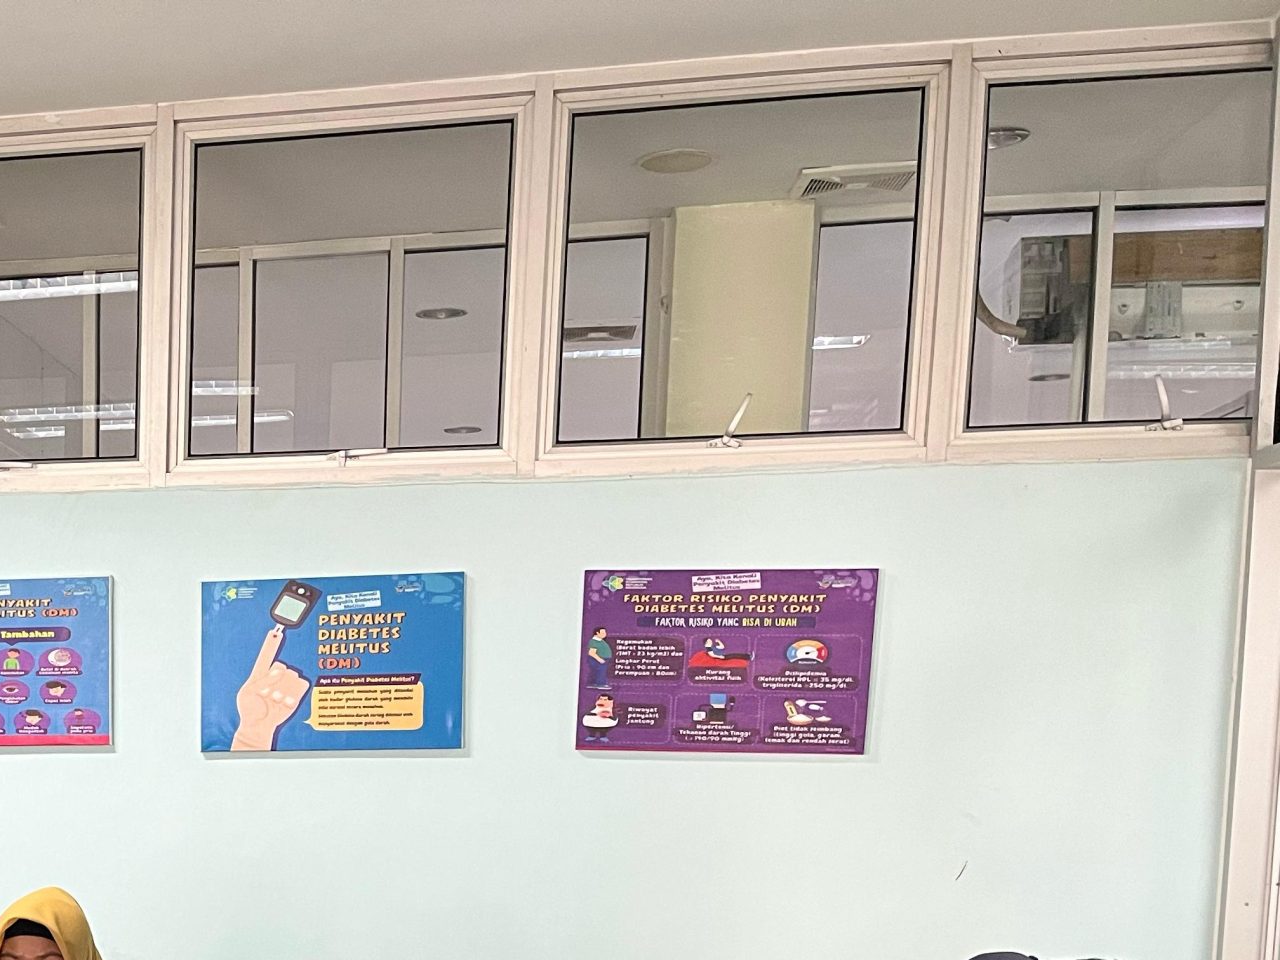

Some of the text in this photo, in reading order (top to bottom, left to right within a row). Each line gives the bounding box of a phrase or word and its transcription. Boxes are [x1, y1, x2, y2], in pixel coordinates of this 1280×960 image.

[624, 594, 827, 603] FAKTOR RISIKO PENYAKIT
[41, 609, 79, 617] (DM)
[634, 604, 821, 613] DIABETES MELITUS (DM)
[319, 612, 406, 626] PENYAKIT
[655, 617, 797, 627] FAKTOR RISIKO YANG BISA DI UBAH
[319, 627, 401, 640] DIABETES
[318, 642, 391, 655] MELITUS
[318, 658, 361, 669] (DM)
